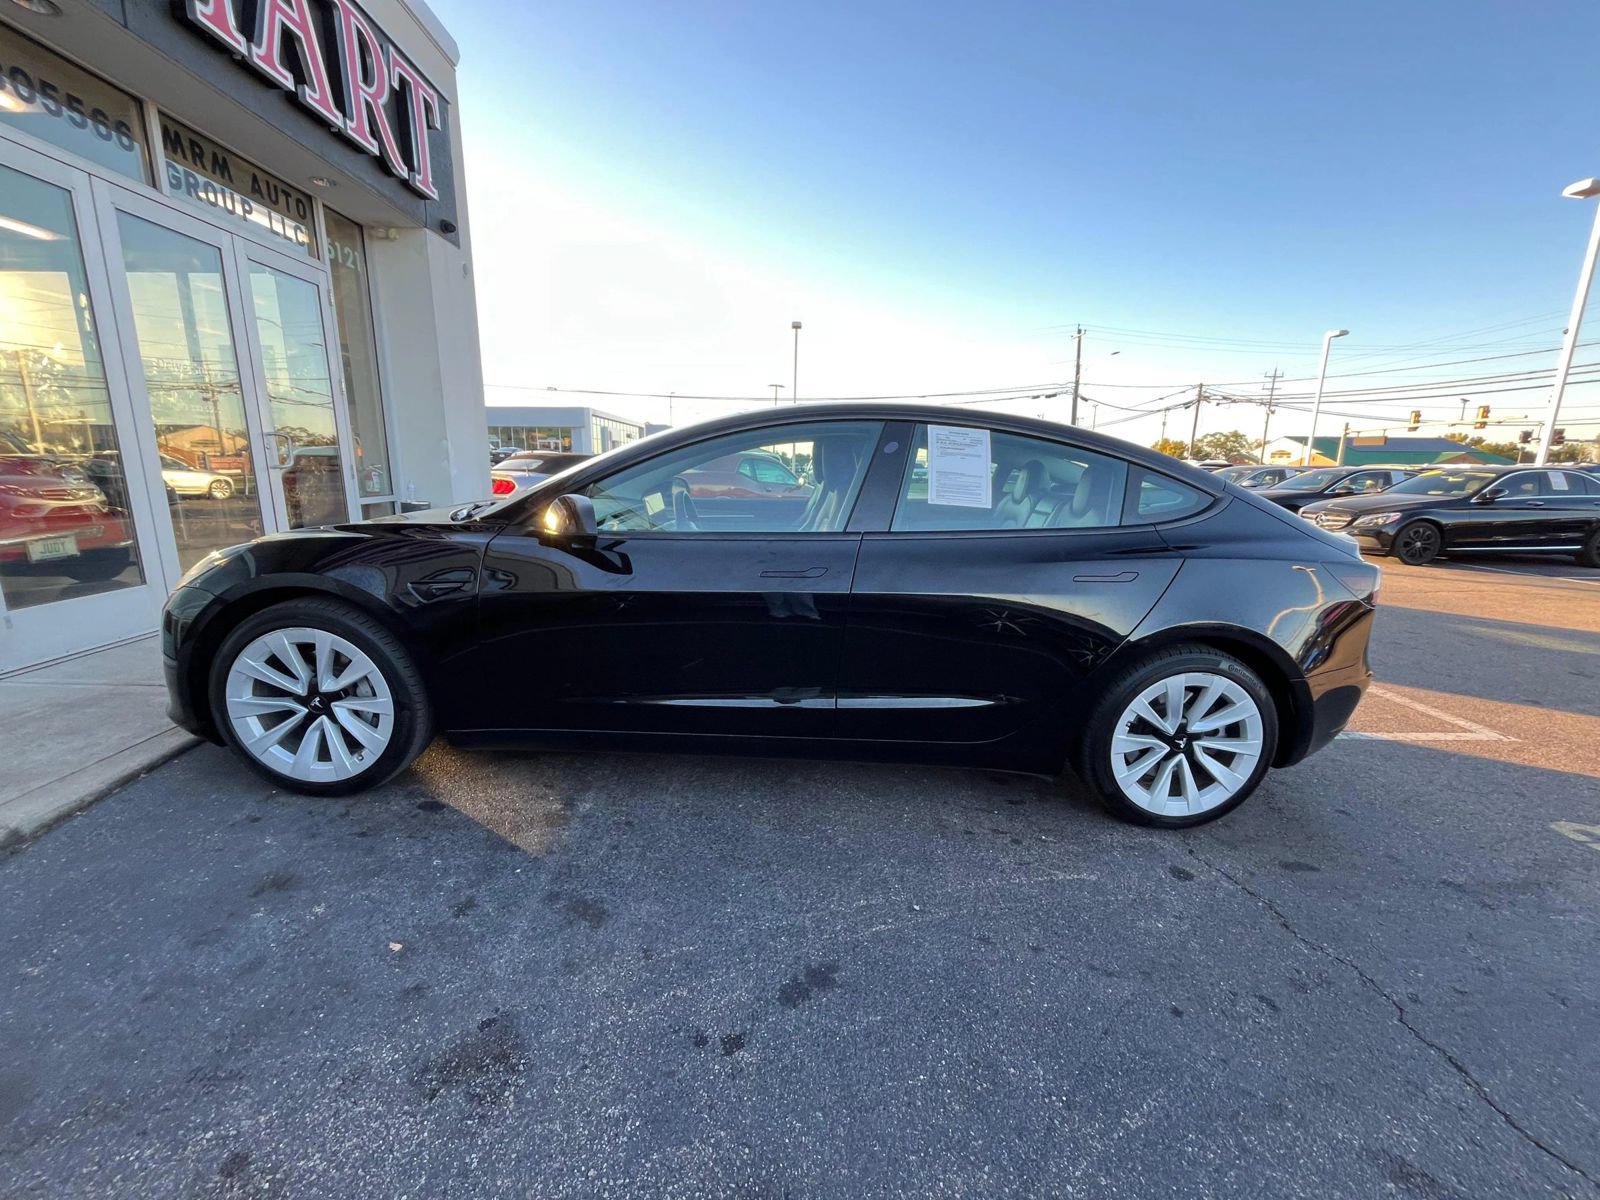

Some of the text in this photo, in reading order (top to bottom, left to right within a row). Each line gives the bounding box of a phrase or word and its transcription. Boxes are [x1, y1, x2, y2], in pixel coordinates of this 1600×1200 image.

[0, 63, 135, 153] 05566
[162, 124, 307, 220] MRM AUTO
[165, 159, 306, 247] GROUP LLC
